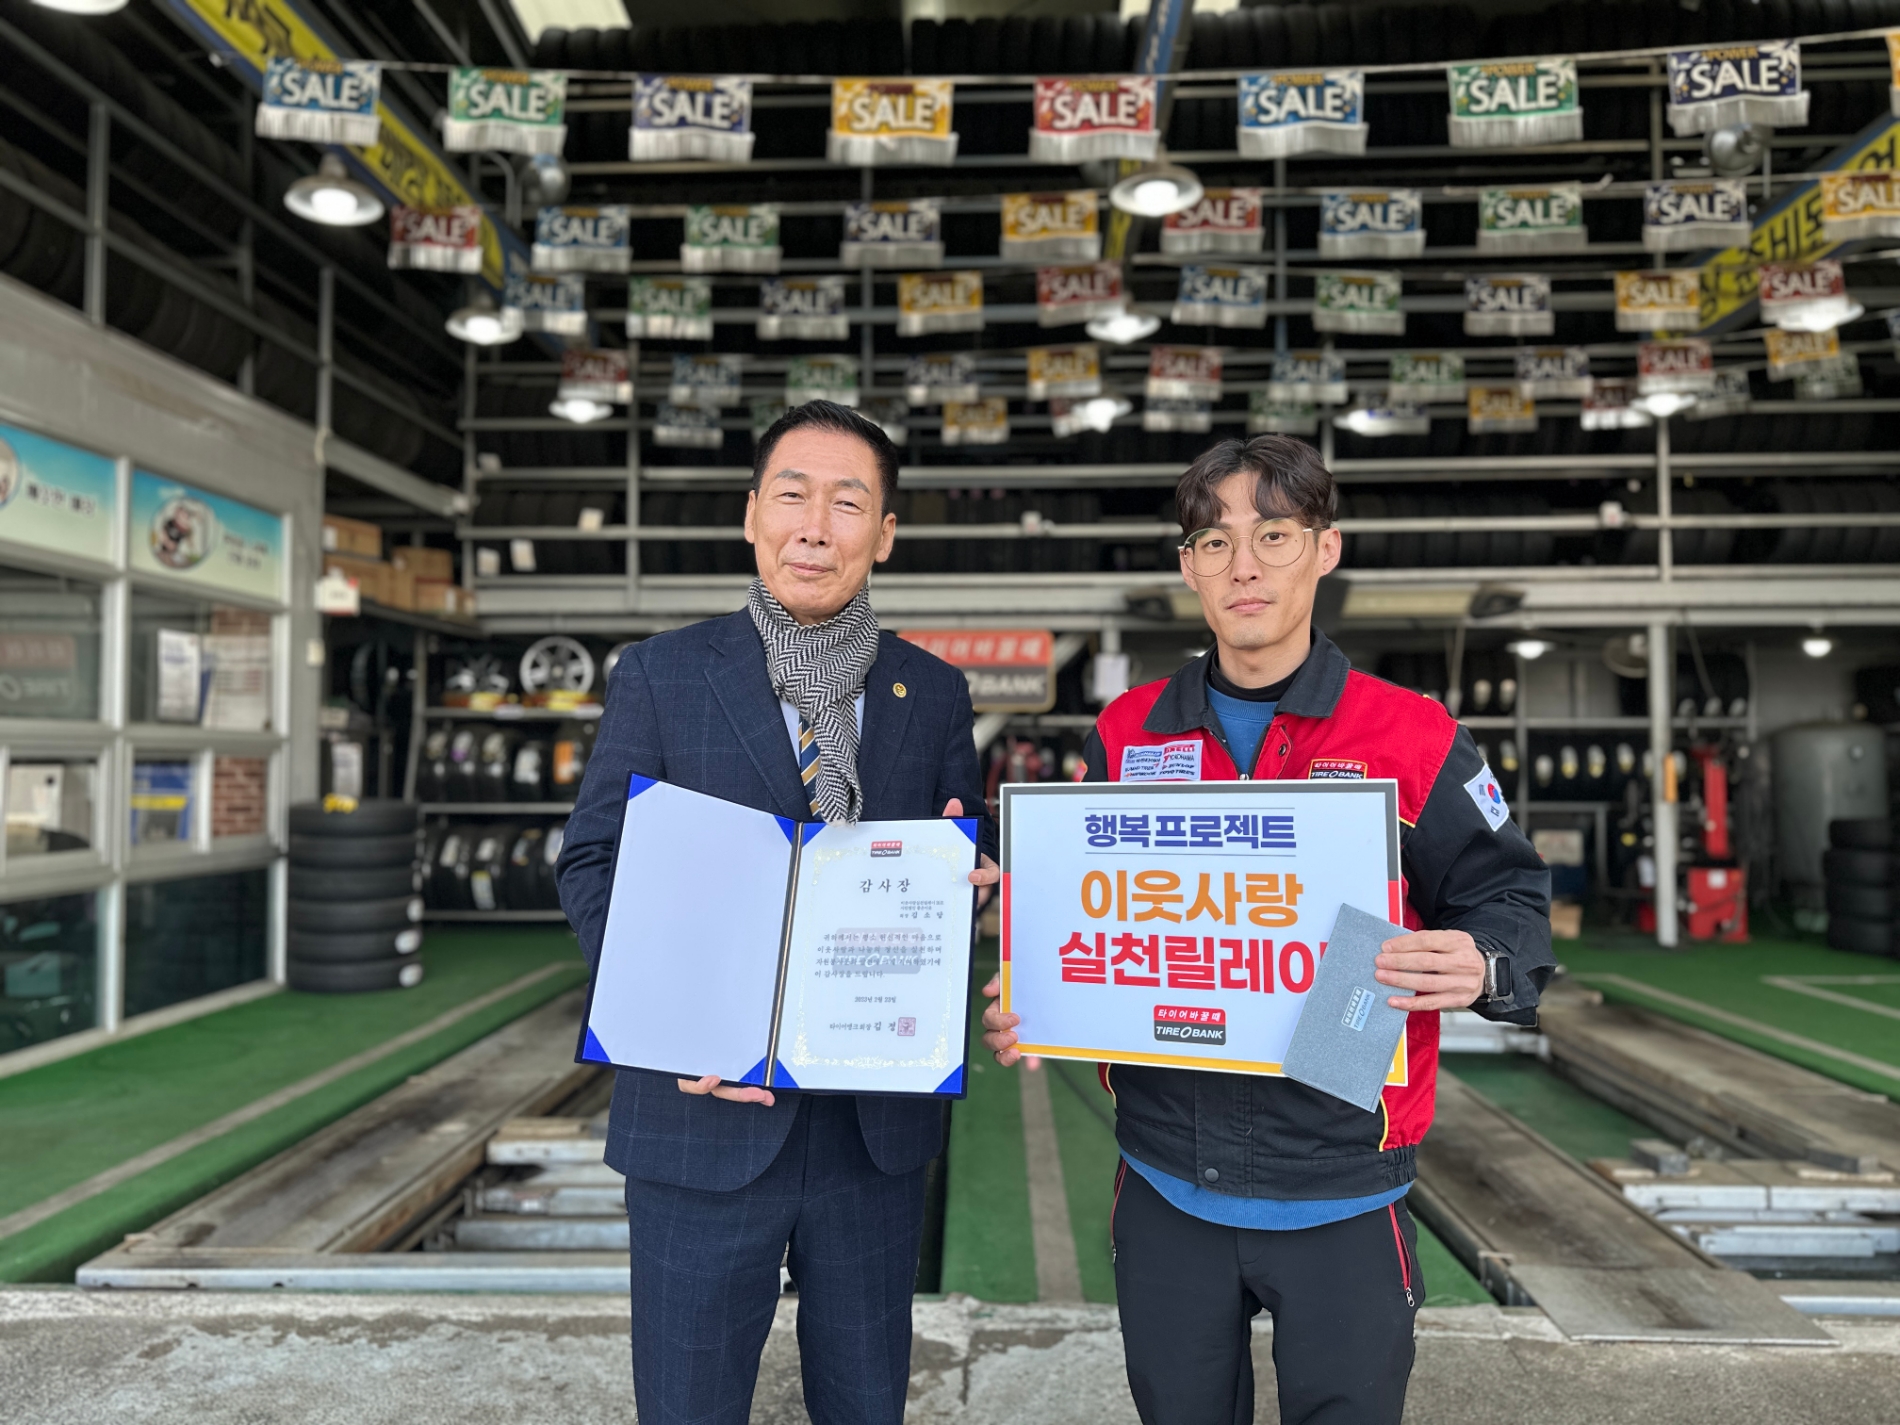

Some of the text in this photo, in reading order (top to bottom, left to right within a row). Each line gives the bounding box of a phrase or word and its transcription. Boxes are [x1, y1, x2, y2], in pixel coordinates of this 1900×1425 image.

[282, 71, 360, 110] SALE
[1690, 58, 1781, 98] SALE
[467, 81, 548, 120] SALE
[1257, 86, 1345, 124] SALE
[1468, 75, 1560, 113] SALE
[651, 92, 731, 129] SALE
[850, 94, 935, 131] SALE
[1052, 92, 1139, 129] SALE
[1016, 201, 1085, 234] SALE
[1177, 199, 1248, 227] SALE
[1334, 204, 1406, 231] SALE
[1495, 202, 1568, 227] SALE
[1659, 194, 1732, 224] SALE
[404, 213, 467, 246] SALE
[551, 216, 616, 245] SALE
[701, 217, 764, 245] SALE
[858, 211, 925, 241] SALE
[913, 282, 968, 308] SALE
[1051, 275, 1108, 299] SALE
[1192, 276, 1251, 301] SALE
[1329, 285, 1386, 309] SALE
[1629, 279, 1688, 305] SALE
[1770, 270, 1834, 298] SALE
[643, 289, 697, 312] SALE
[774, 288, 828, 314] SALE
[1478, 286, 1535, 312] SALE
[1084, 814, 1297, 849] 행복프로젝트
[1080, 869, 1304, 928] 이웃사랑
